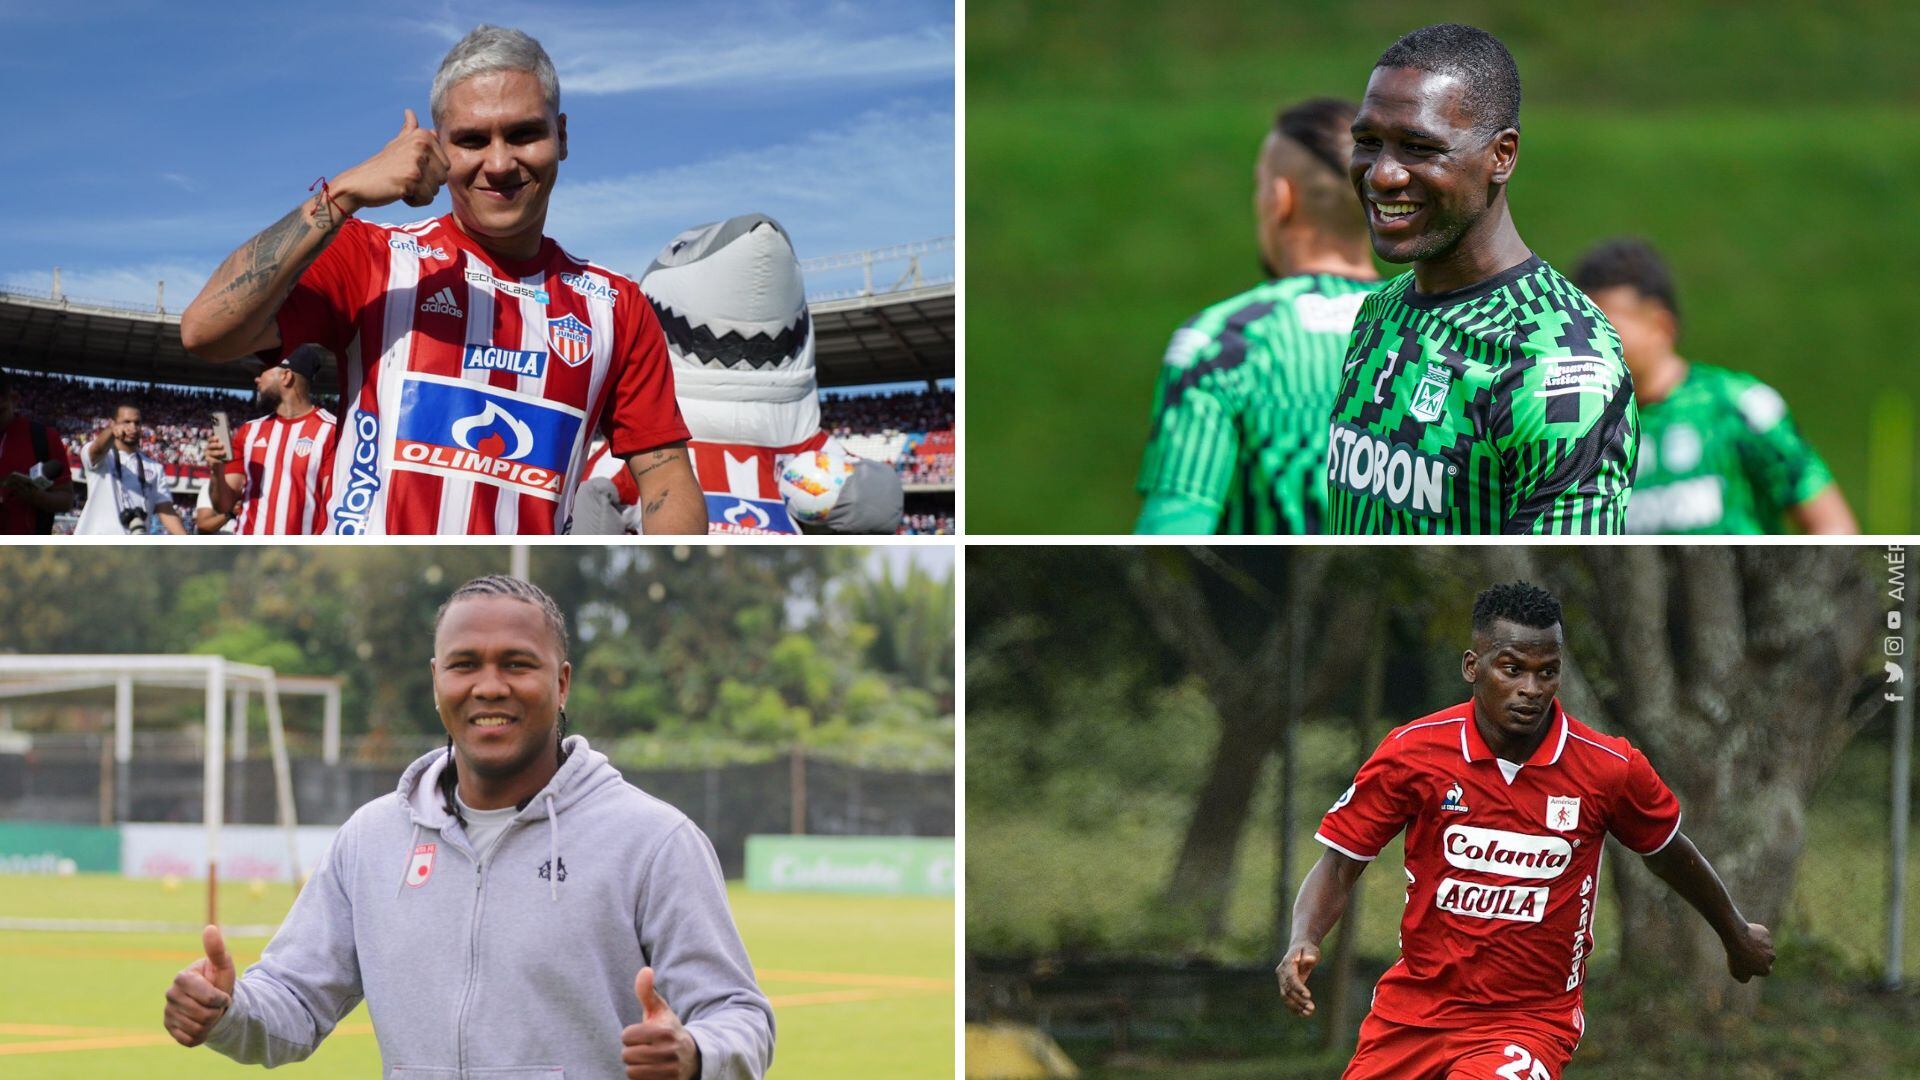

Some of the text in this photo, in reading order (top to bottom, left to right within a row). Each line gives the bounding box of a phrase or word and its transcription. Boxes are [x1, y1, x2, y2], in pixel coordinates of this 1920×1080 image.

[420, 301, 463, 318] adidas
[556, 330, 586, 343] JUNIOR
[468, 346, 538, 376] AGUILA
[402, 443, 562, 493] OLIMPICA
[1447, 832, 1567, 869] Colanta
[1441, 884, 1537, 917] AGUILA
